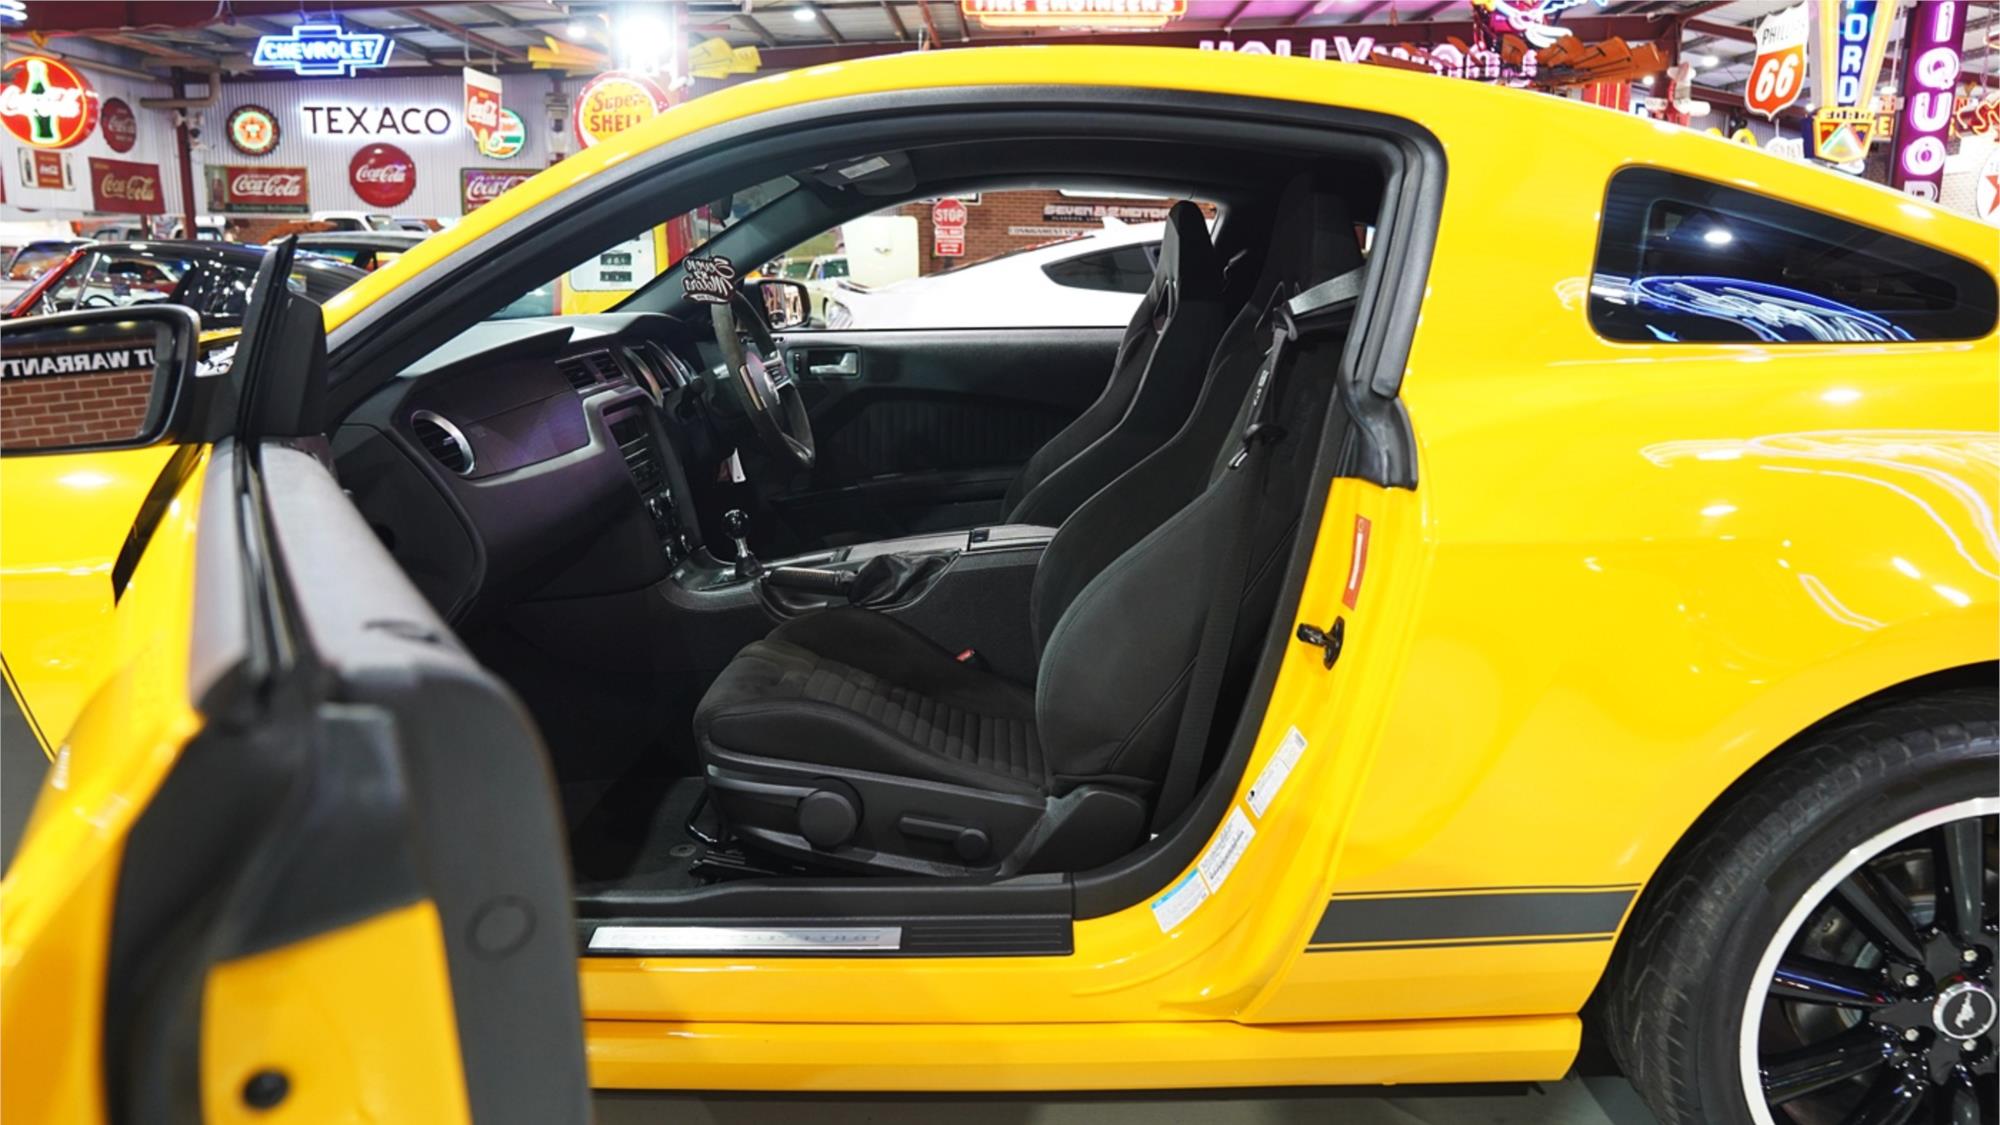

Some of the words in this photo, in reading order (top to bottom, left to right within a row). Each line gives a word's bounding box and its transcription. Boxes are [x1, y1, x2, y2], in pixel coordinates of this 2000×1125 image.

[264, 41, 375, 60] CHEVROLET
[1838, 0, 1868, 103] ORD
[1755, 53, 1798, 102] 66
[304, 106, 451, 134] TEXACO
[935, 208, 965, 222] STOP
